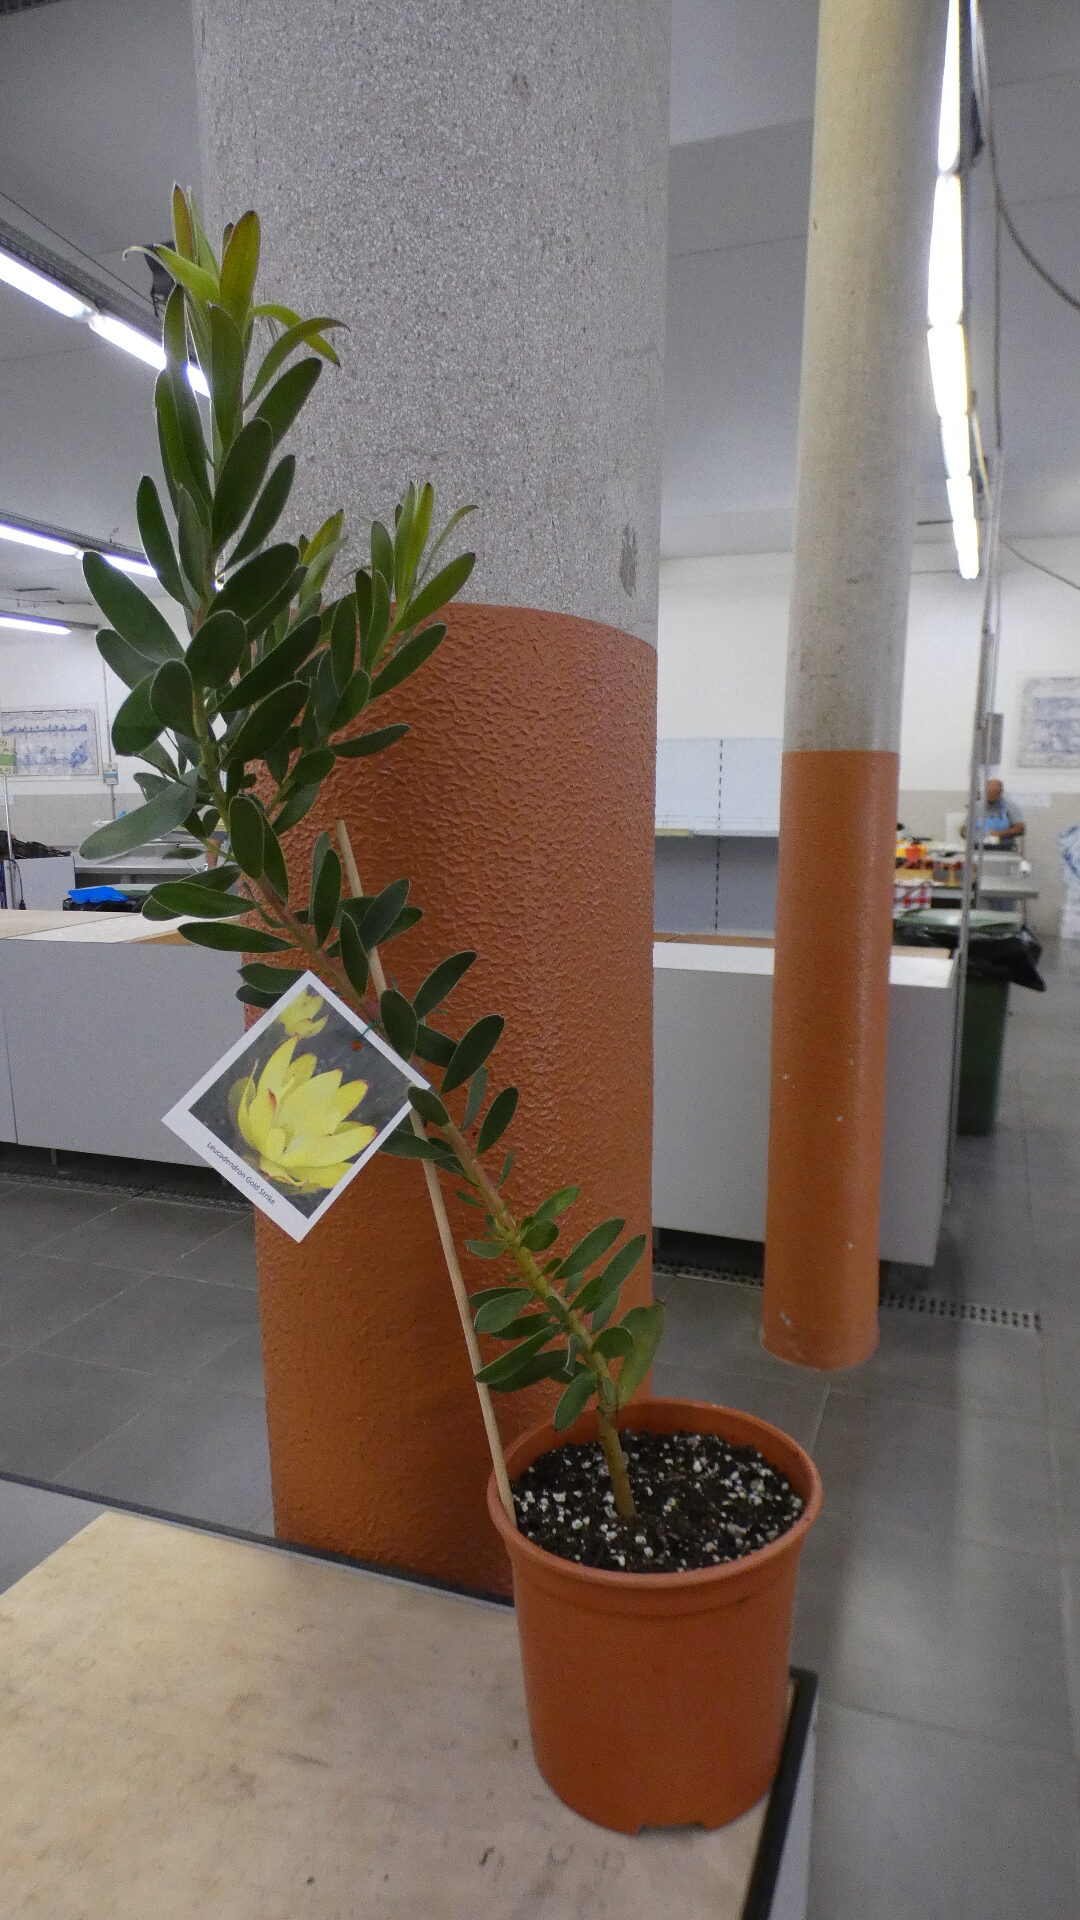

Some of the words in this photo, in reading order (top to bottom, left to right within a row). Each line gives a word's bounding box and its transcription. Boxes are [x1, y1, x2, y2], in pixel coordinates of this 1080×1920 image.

[207, 1142, 246, 1178] Leucadendron
[245, 1176, 260, 1191] Gold
[259, 1188, 276, 1205] Strike
